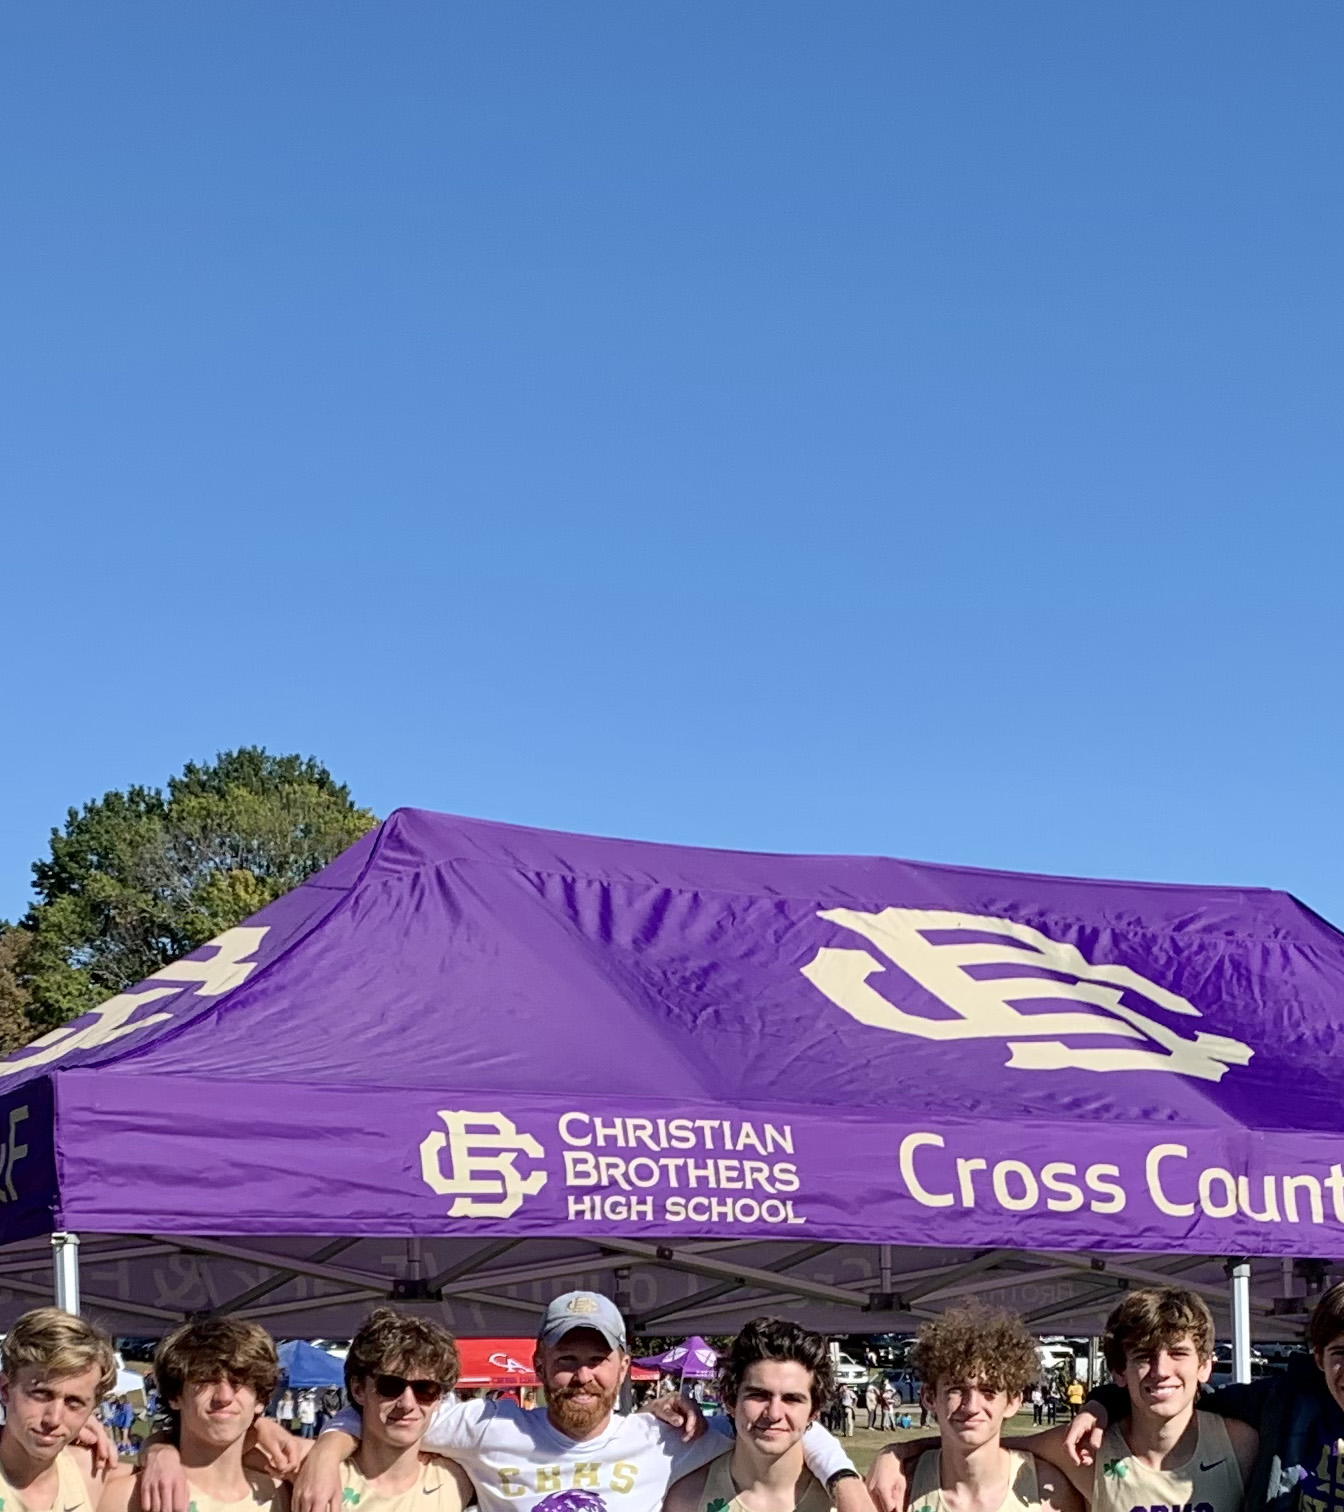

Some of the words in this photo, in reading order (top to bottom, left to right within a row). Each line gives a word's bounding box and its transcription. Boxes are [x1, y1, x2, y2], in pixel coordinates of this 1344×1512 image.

[558, 1112, 795, 1155] CHRISTIAN
[563, 1151, 800, 1193] BROTHERS
[898, 1132, 1126, 1214] Cross
[568, 1195, 653, 1221] HIGH
[665, 1198, 807, 1224] SCHOOL
[498, 1462, 639, 1497] CBHS
